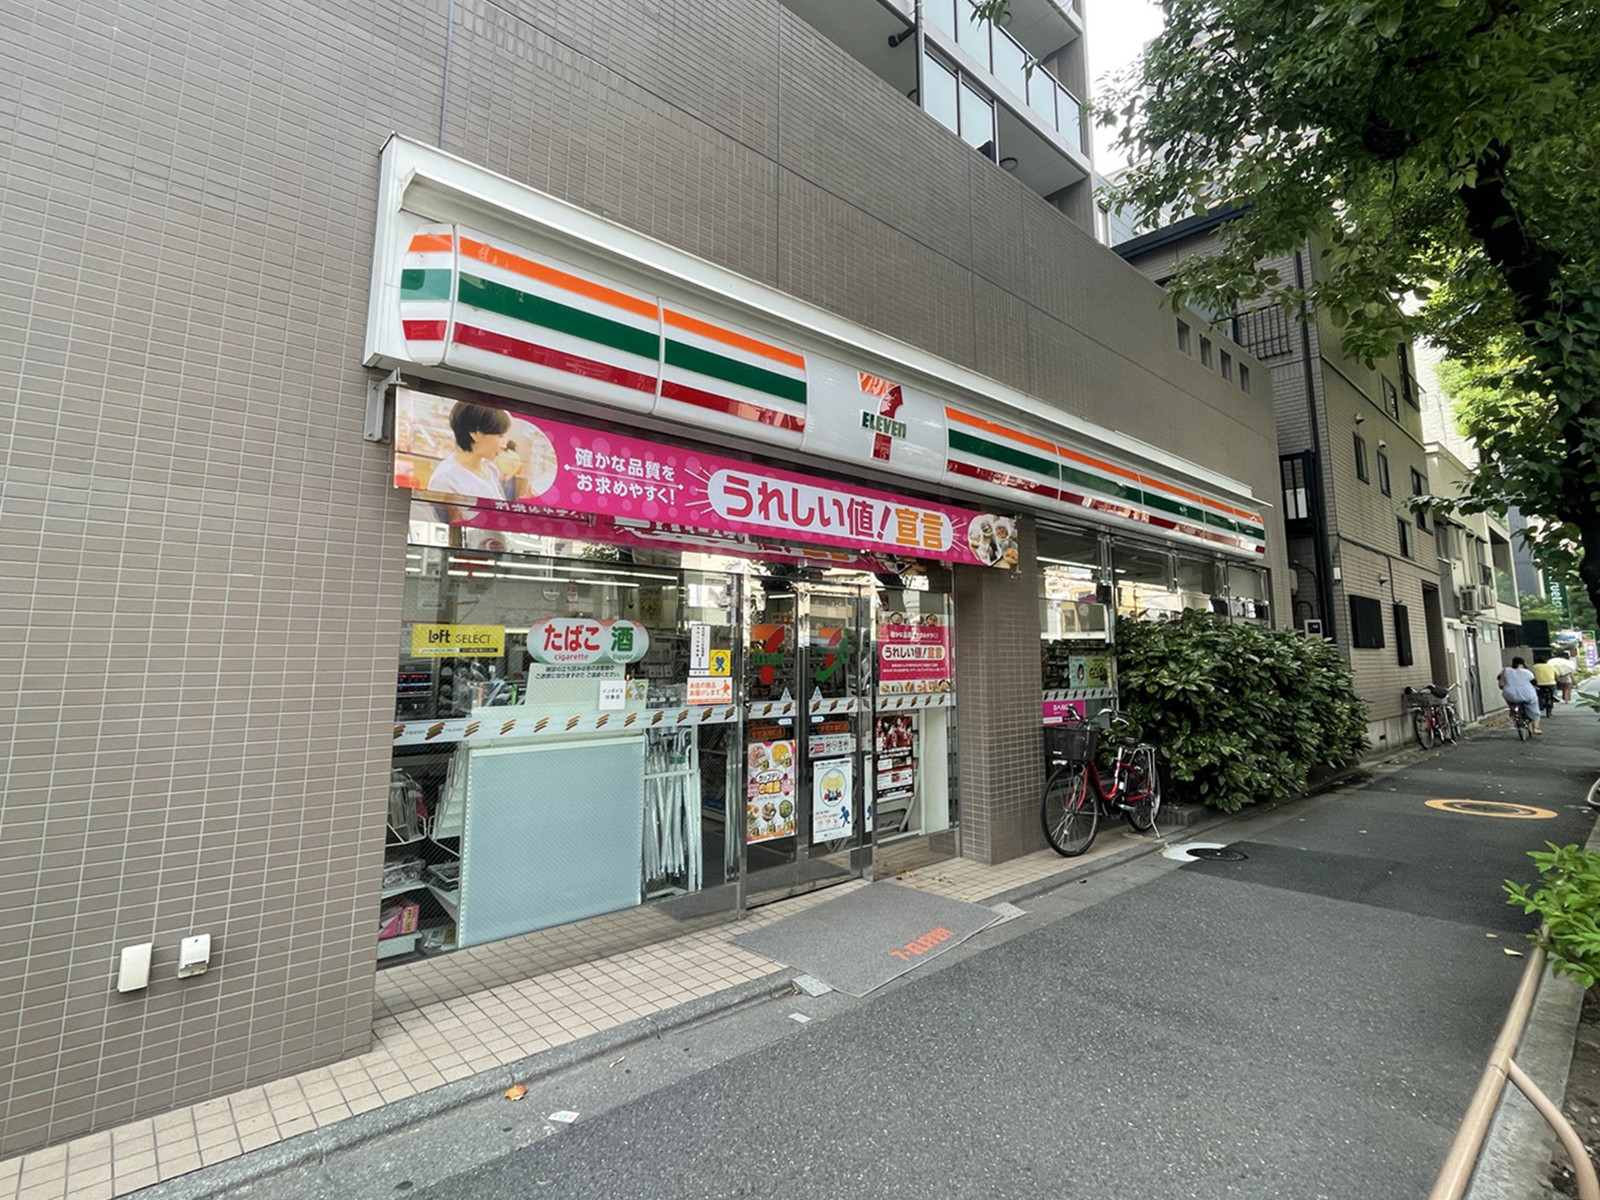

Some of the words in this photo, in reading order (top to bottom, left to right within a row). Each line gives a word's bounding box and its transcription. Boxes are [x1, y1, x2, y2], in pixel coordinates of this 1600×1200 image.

[575, 447, 675, 482] 確かな品質を
[576, 474, 675, 505] お求めやすく!
[723, 474, 944, 549] うれしい値!宣言
[428, 629, 451, 644] Loft
[455, 634, 491, 644] SELECT
[543, 624, 600, 651] たばこ
[611, 626, 634, 651] 酒
